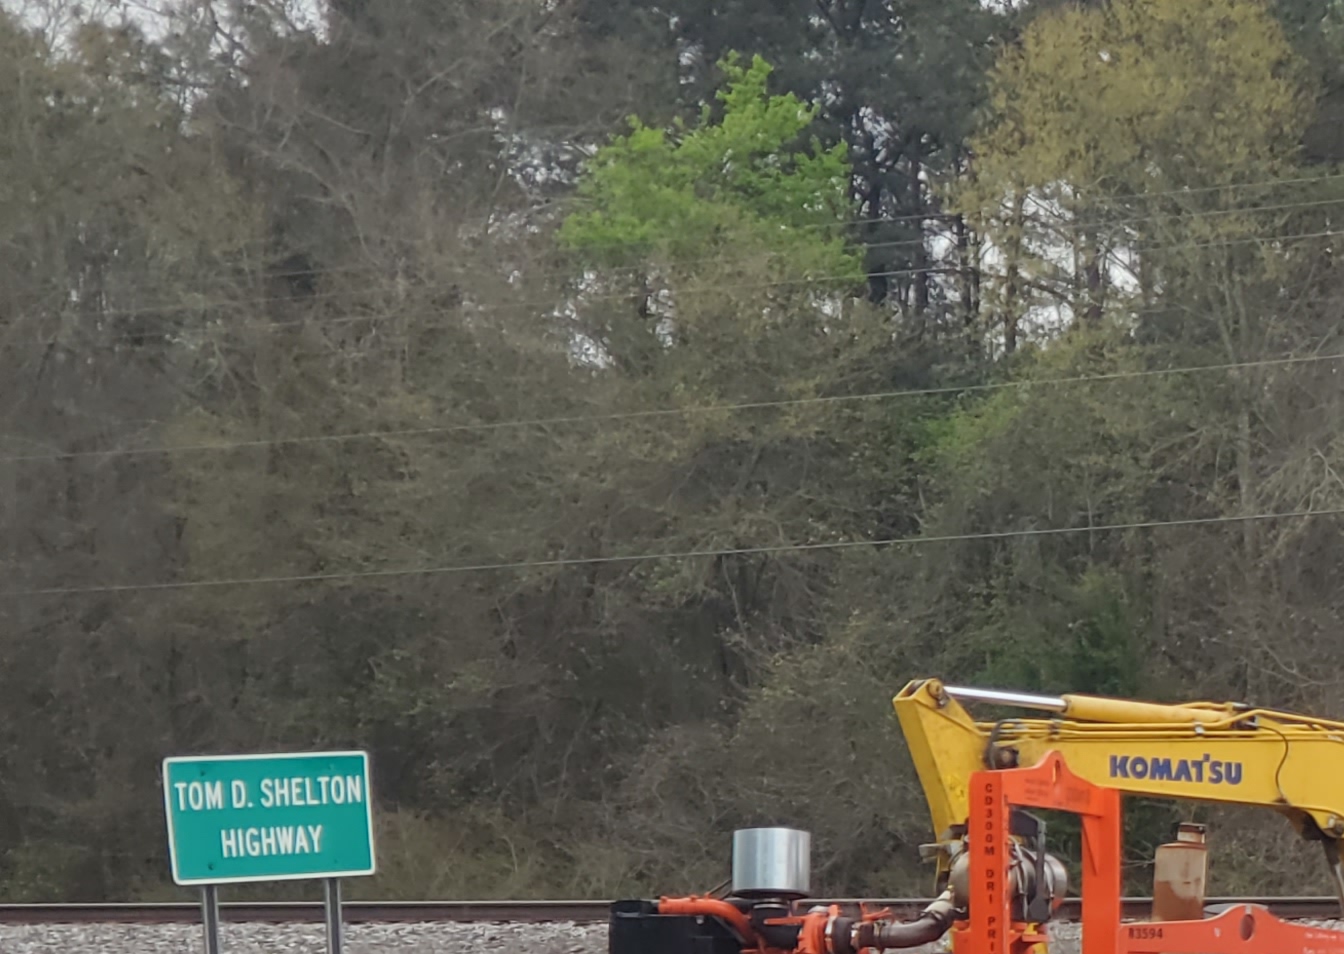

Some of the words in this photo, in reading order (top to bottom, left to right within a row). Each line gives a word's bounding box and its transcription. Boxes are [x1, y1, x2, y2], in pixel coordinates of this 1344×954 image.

[1109, 753, 1242, 785] KOMATSU
[174, 780, 223, 811] TOM
[231, 779, 254, 809] D.
[260, 774, 362, 808] SHELTON
[984, 783, 995, 856] CD300M
[221, 824, 322, 858] HIGHWAY
[986, 869, 995, 904] DRI
